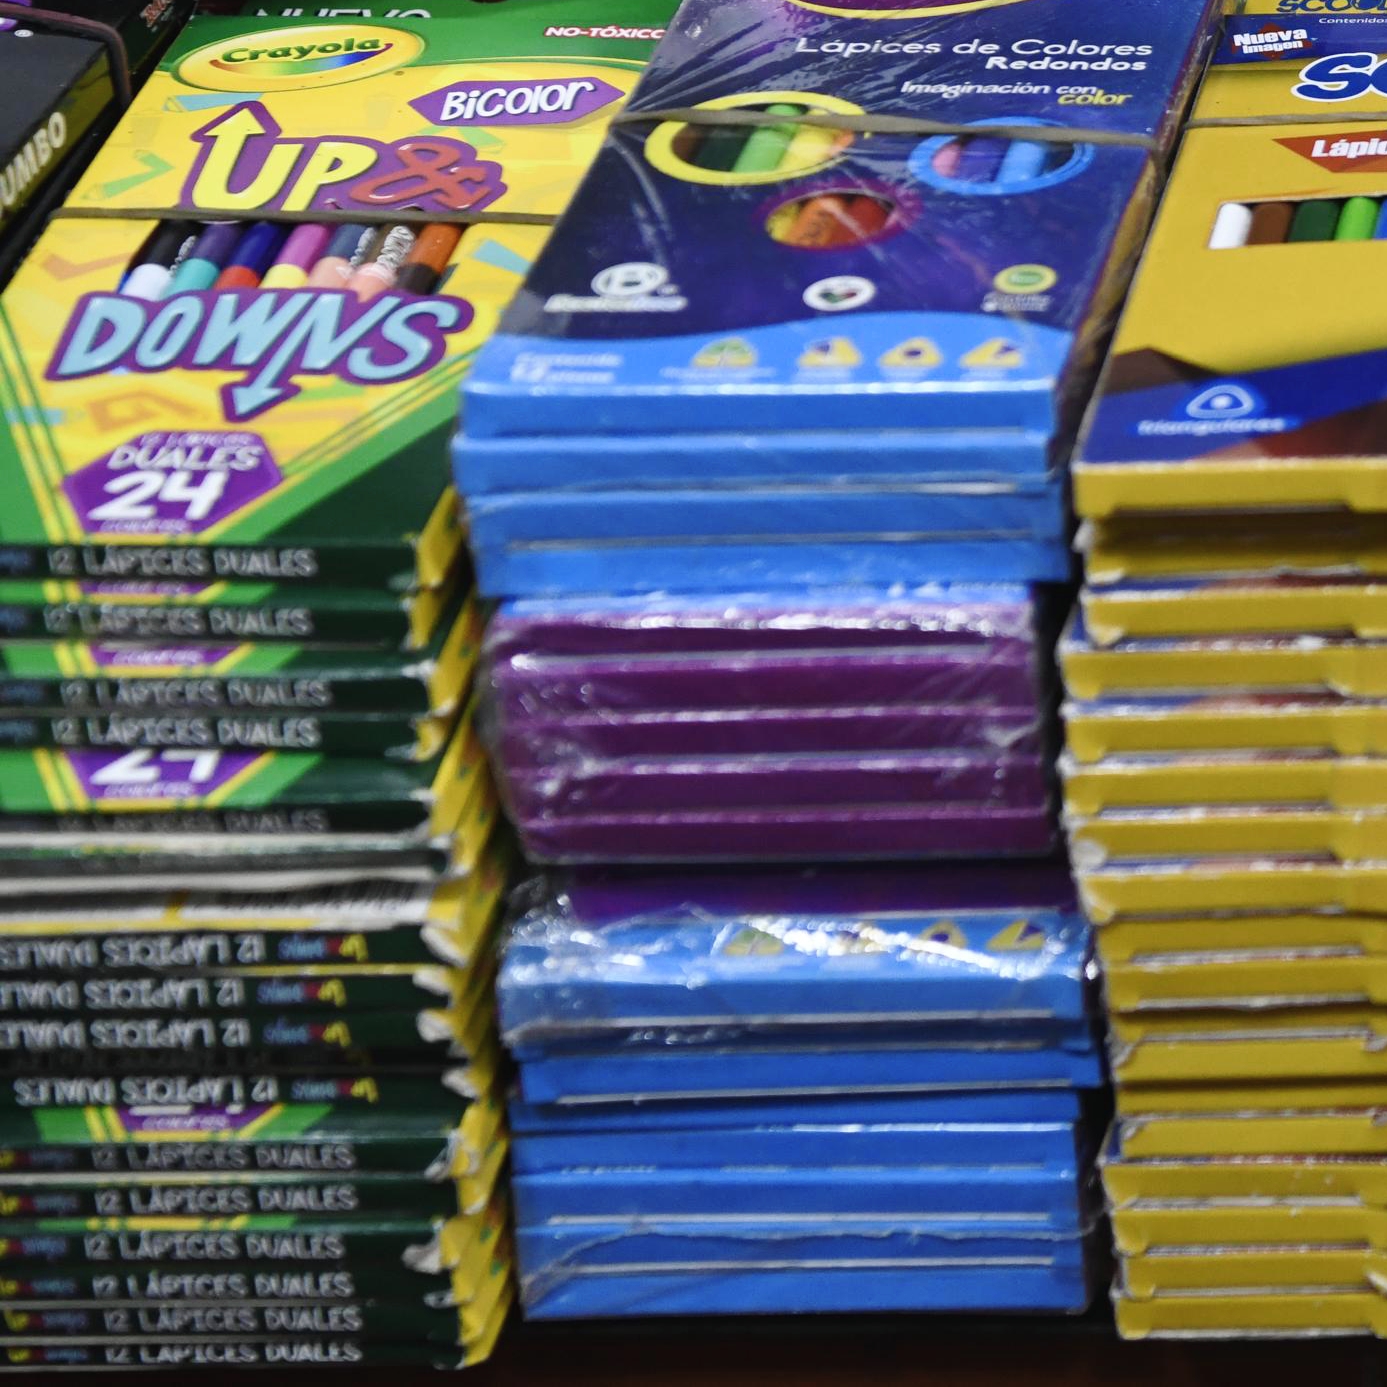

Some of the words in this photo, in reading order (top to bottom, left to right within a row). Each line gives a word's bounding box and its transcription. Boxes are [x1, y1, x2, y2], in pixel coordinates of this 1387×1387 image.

[221, 35, 385, 66] Crayola
[798, 35, 941, 61] Lápices
[960, 36, 1000, 56] de
[1012, 35, 1153, 58] Colores
[1233, 27, 1307, 47] Nueva
[1243, 39, 1304, 55] Imagen
[985, 54, 1147, 73] Redondos
[901, 79, 1053, 101] Imaginación
[1057, 82, 1099, 97] con
[1057, 89, 1134, 108] color
[0, 112, 67, 208] UMBO
[192, 101, 378, 212] UP
[56, 292, 461, 415] DOWNS
[107, 445, 265, 471] DUALES
[87, 470, 230, 521] 24
[213, 547, 319, 577] DUALES
[227, 679, 333, 707] DUALES
[217, 717, 322, 747] DUALES
[255, 1144, 357, 1169] DUALES
[257, 1184, 360, 1212] DUALES
[245, 1232, 347, 1260] DUALES
[254, 1271, 356, 1299] DUALES
[264, 1305, 364, 1333] DUALES
